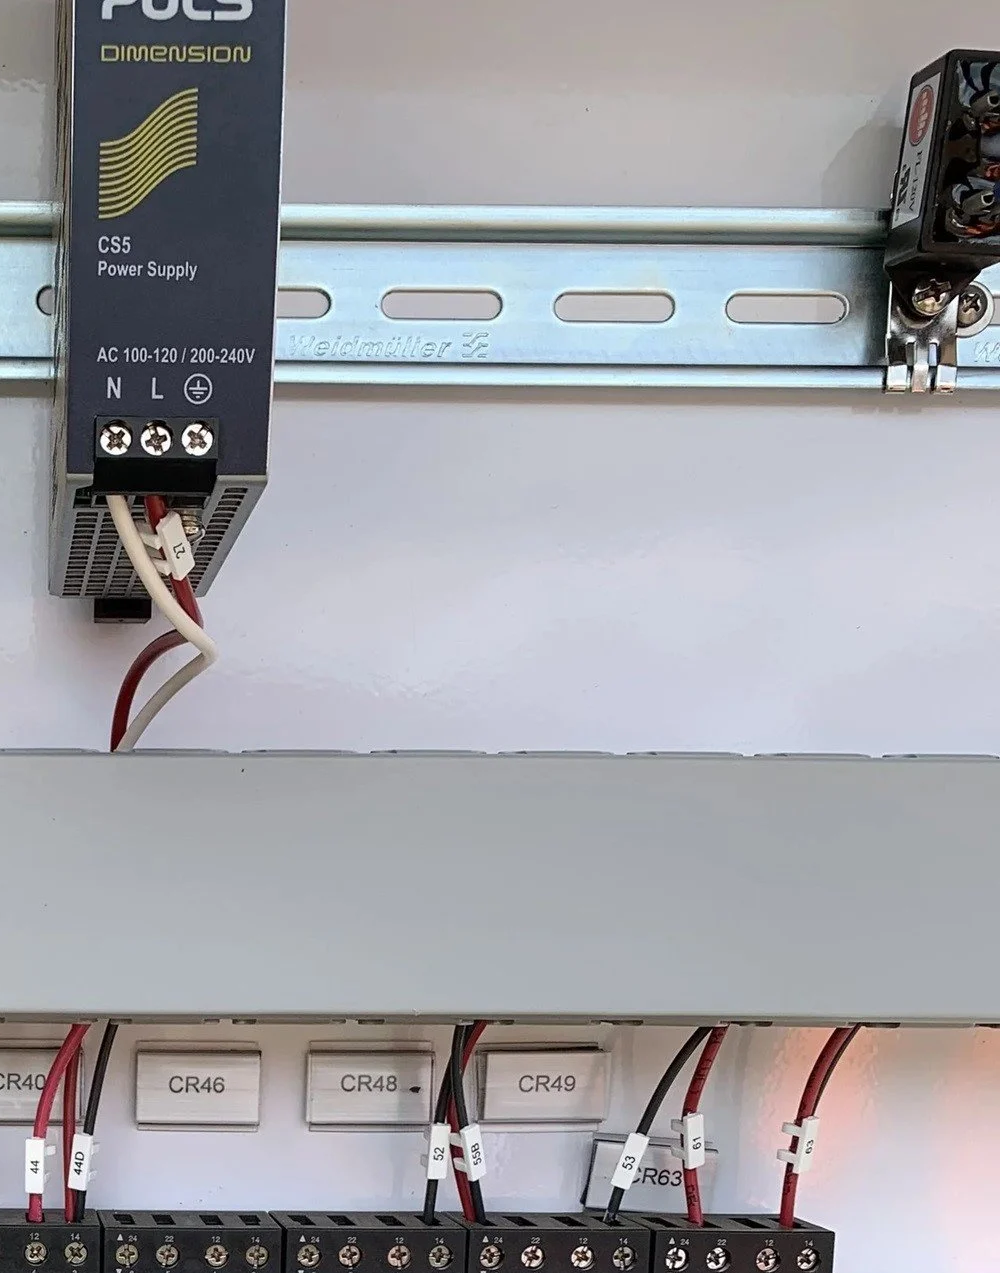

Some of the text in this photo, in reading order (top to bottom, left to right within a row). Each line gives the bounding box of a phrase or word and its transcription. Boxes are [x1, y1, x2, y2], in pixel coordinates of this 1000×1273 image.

[101, 45, 251, 63] DIMENSION
[98, 236, 131, 255] CS5
[98, 261, 198, 281] Power Supply
[289, 334, 453, 358] Weidmüller
[97, 348, 256, 364] AC 100-120 / 200-240V
[106, 377, 164, 399] N L
[168, 1075, 226, 1094] CR46
[340, 1074, 398, 1092] CR48
[518, 1074, 576, 1092] CR49
[692, 1137, 701, 1150] 61
[805, 1140, 814, 1154] 63
[433, 1147, 444, 1161] 52
[471, 1141, 484, 1165] 55B
[30, 1160, 39, 1174] 44
[73, 1151, 84, 1175] 44D
[621, 1154, 637, 1171] 53
[128, 1234, 138, 1242] 24
[164, 1234, 175, 1242] 22
[211, 1236, 221, 1244] 12
